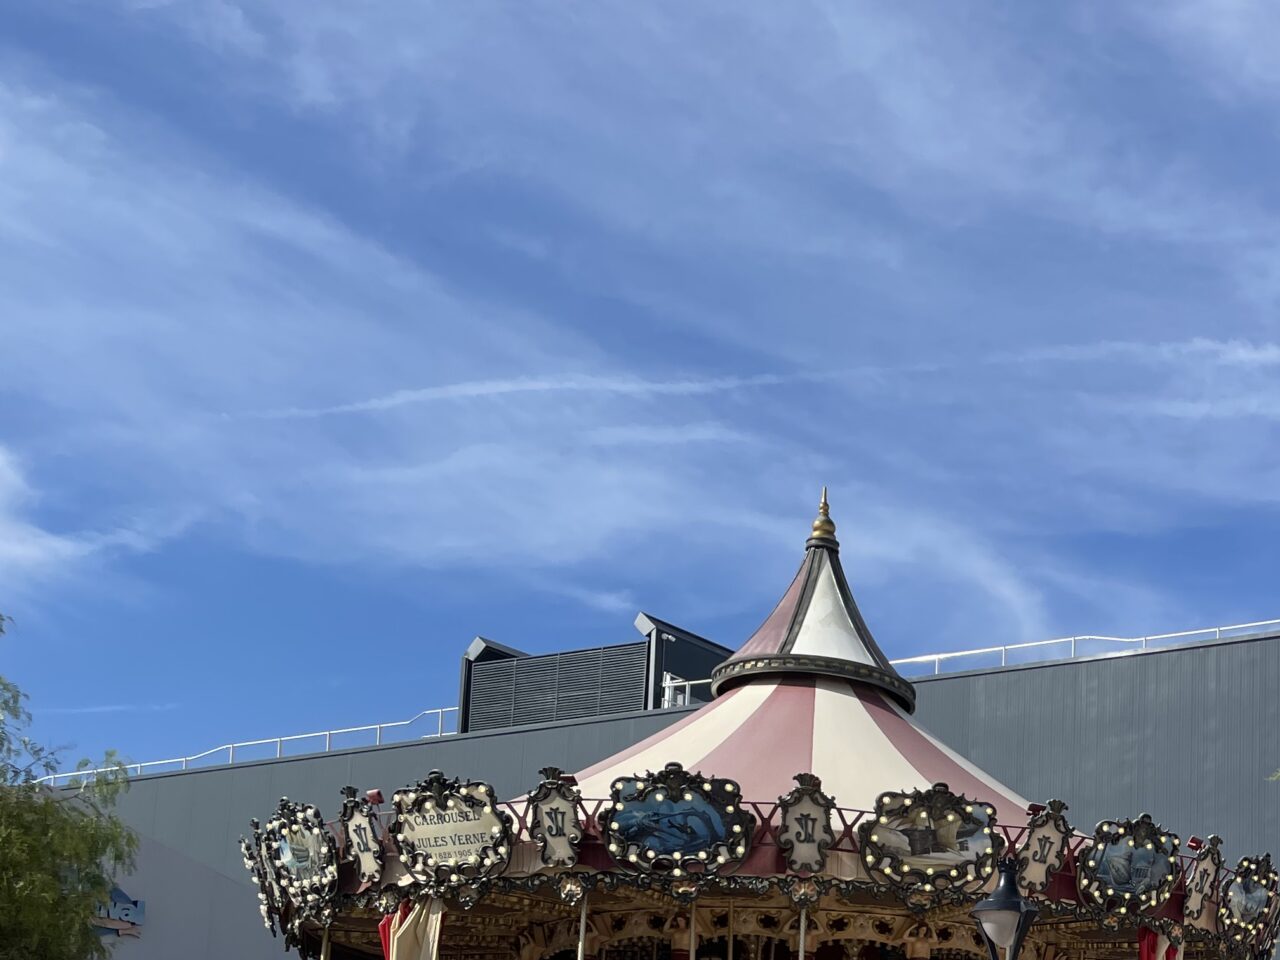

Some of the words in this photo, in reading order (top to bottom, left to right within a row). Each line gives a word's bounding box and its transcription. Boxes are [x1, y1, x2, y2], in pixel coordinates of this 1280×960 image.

[413, 810, 481, 827] CARROUSEL
[415, 836, 449, 849] JULES
[449, 832, 487, 847] VERNE
[453, 848, 472, 858] 1905
